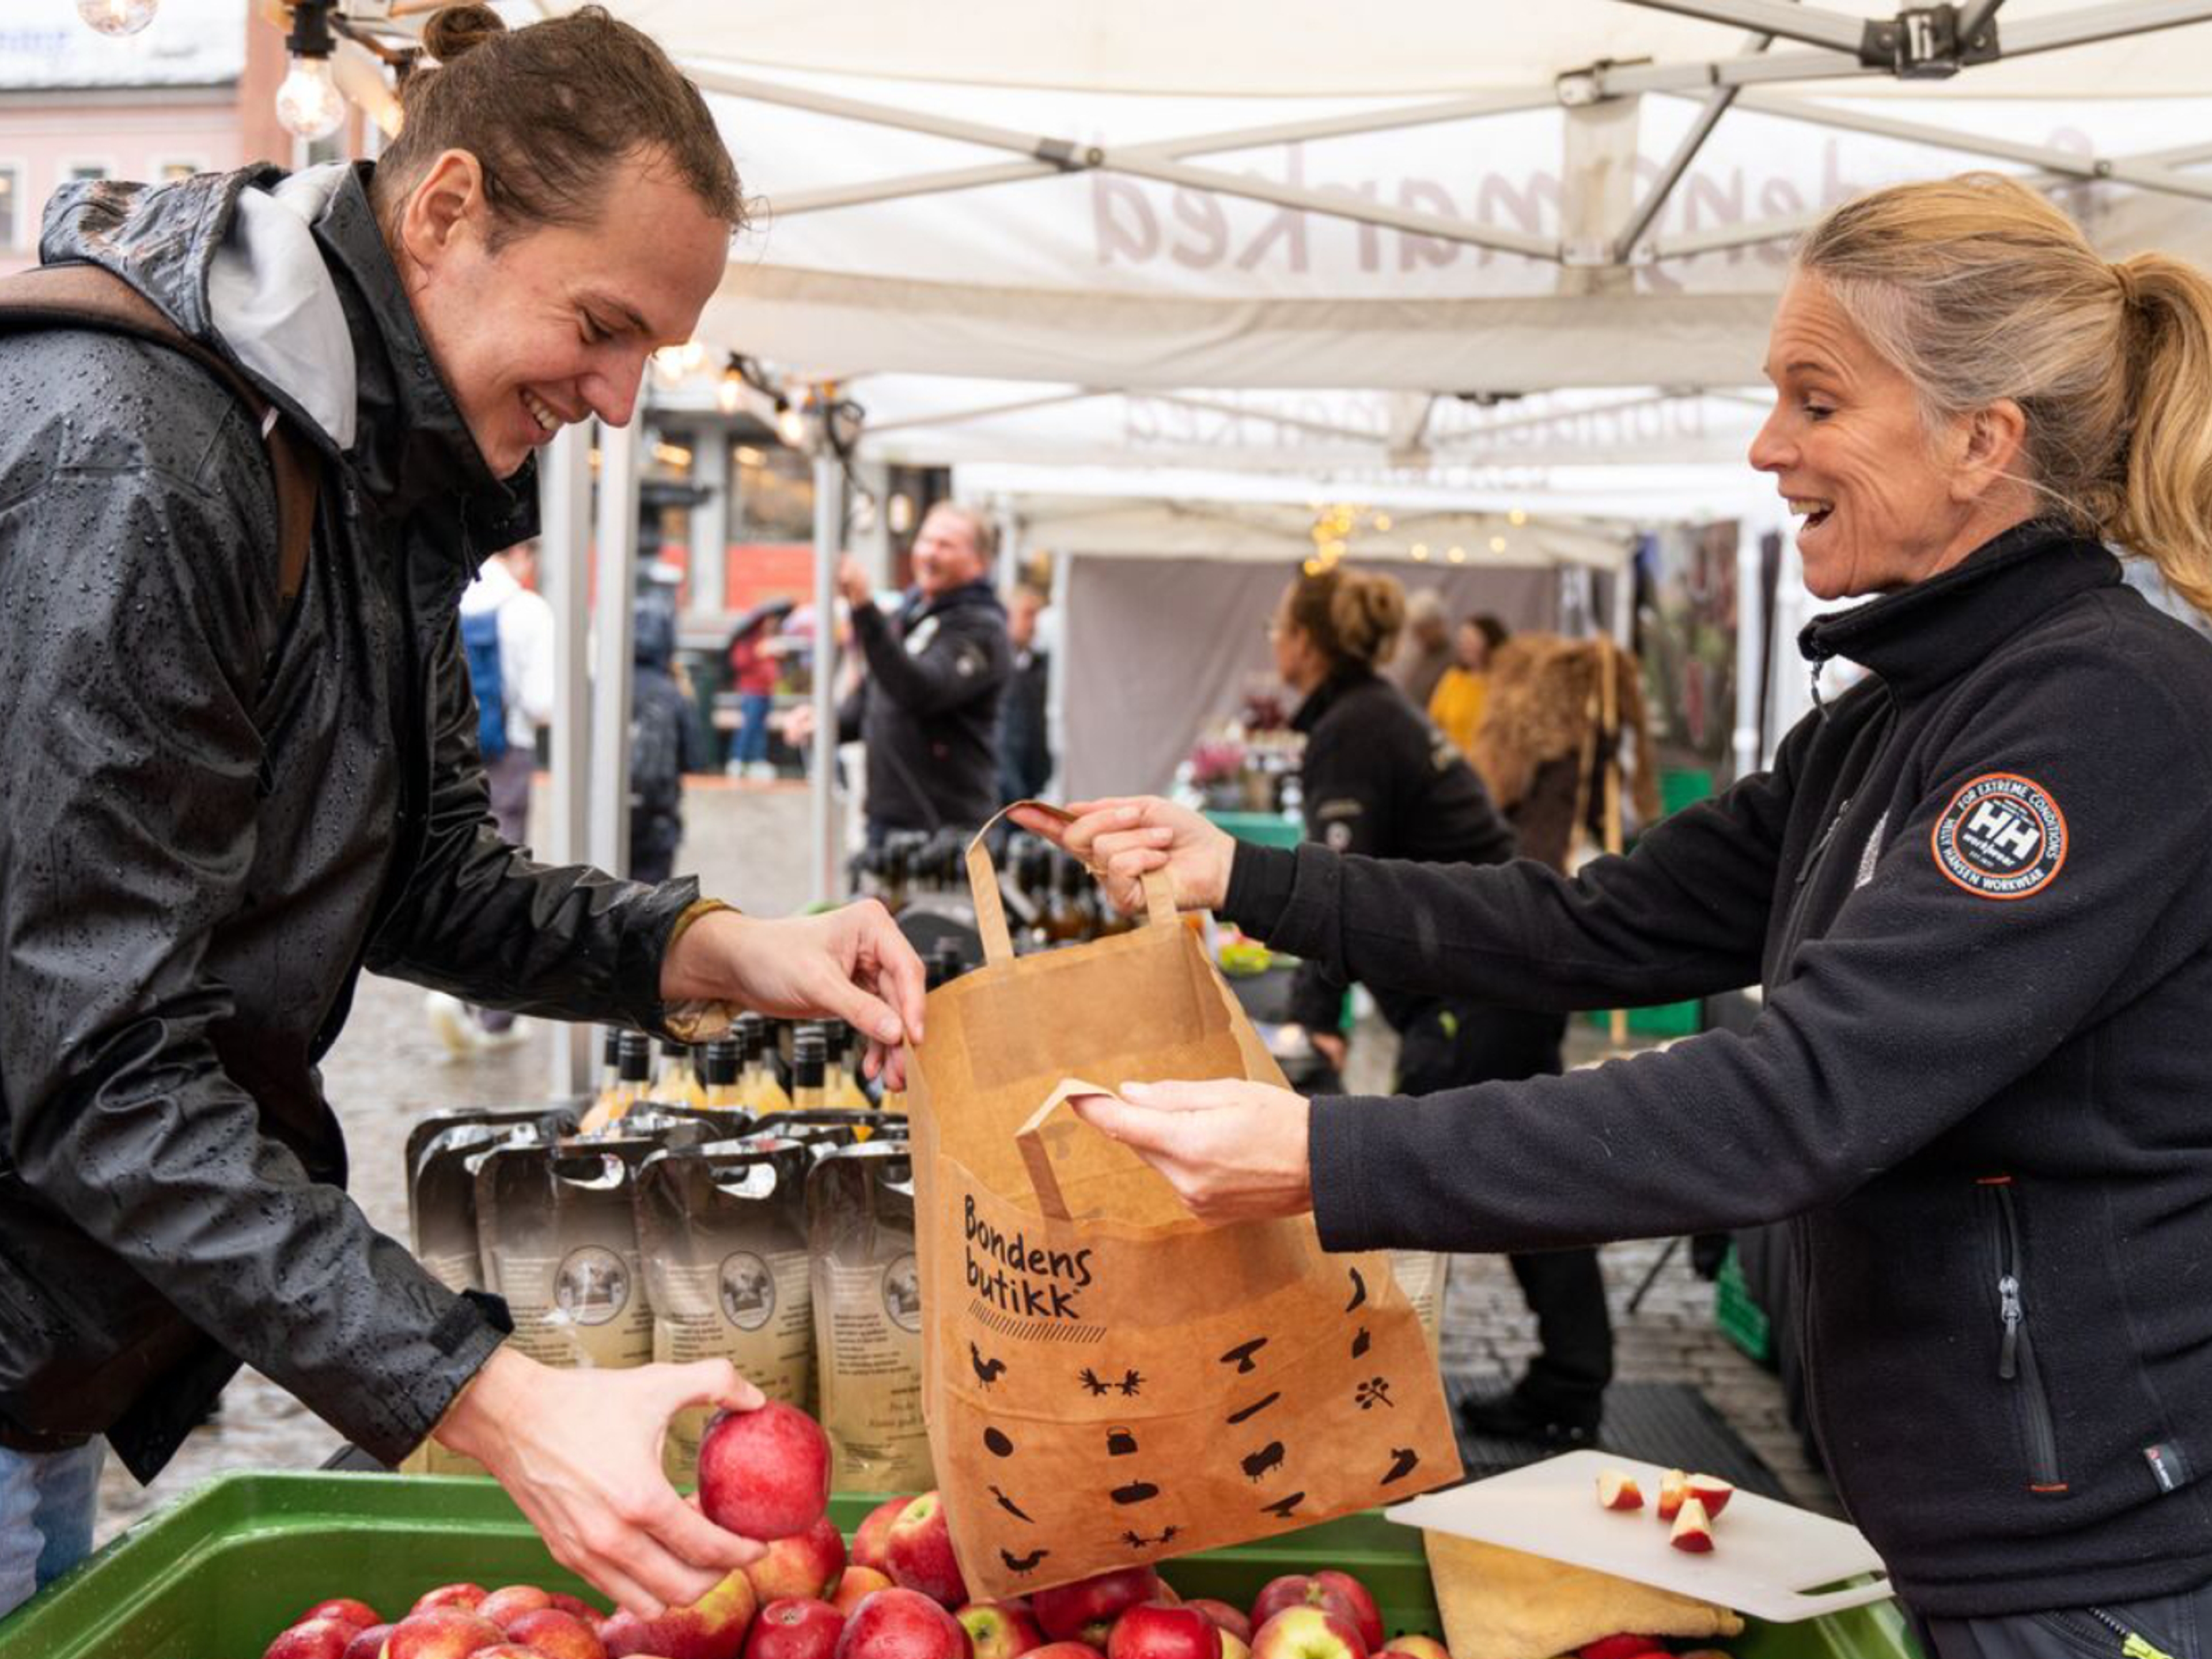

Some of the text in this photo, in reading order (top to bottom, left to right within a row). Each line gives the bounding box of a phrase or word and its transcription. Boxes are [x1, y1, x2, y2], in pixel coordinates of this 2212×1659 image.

[1957, 787, 1977, 811] FOR
[1976, 781, 2028, 797] EXTREME
[2028, 793, 2061, 859] CONDITIONS
[1943, 847, 1980, 885] HANSEN
[1983, 868, 2044, 891] WORKWEAR
[964, 1194, 1093, 1287] Bondens
[966, 1244, 1080, 1320] butikk
